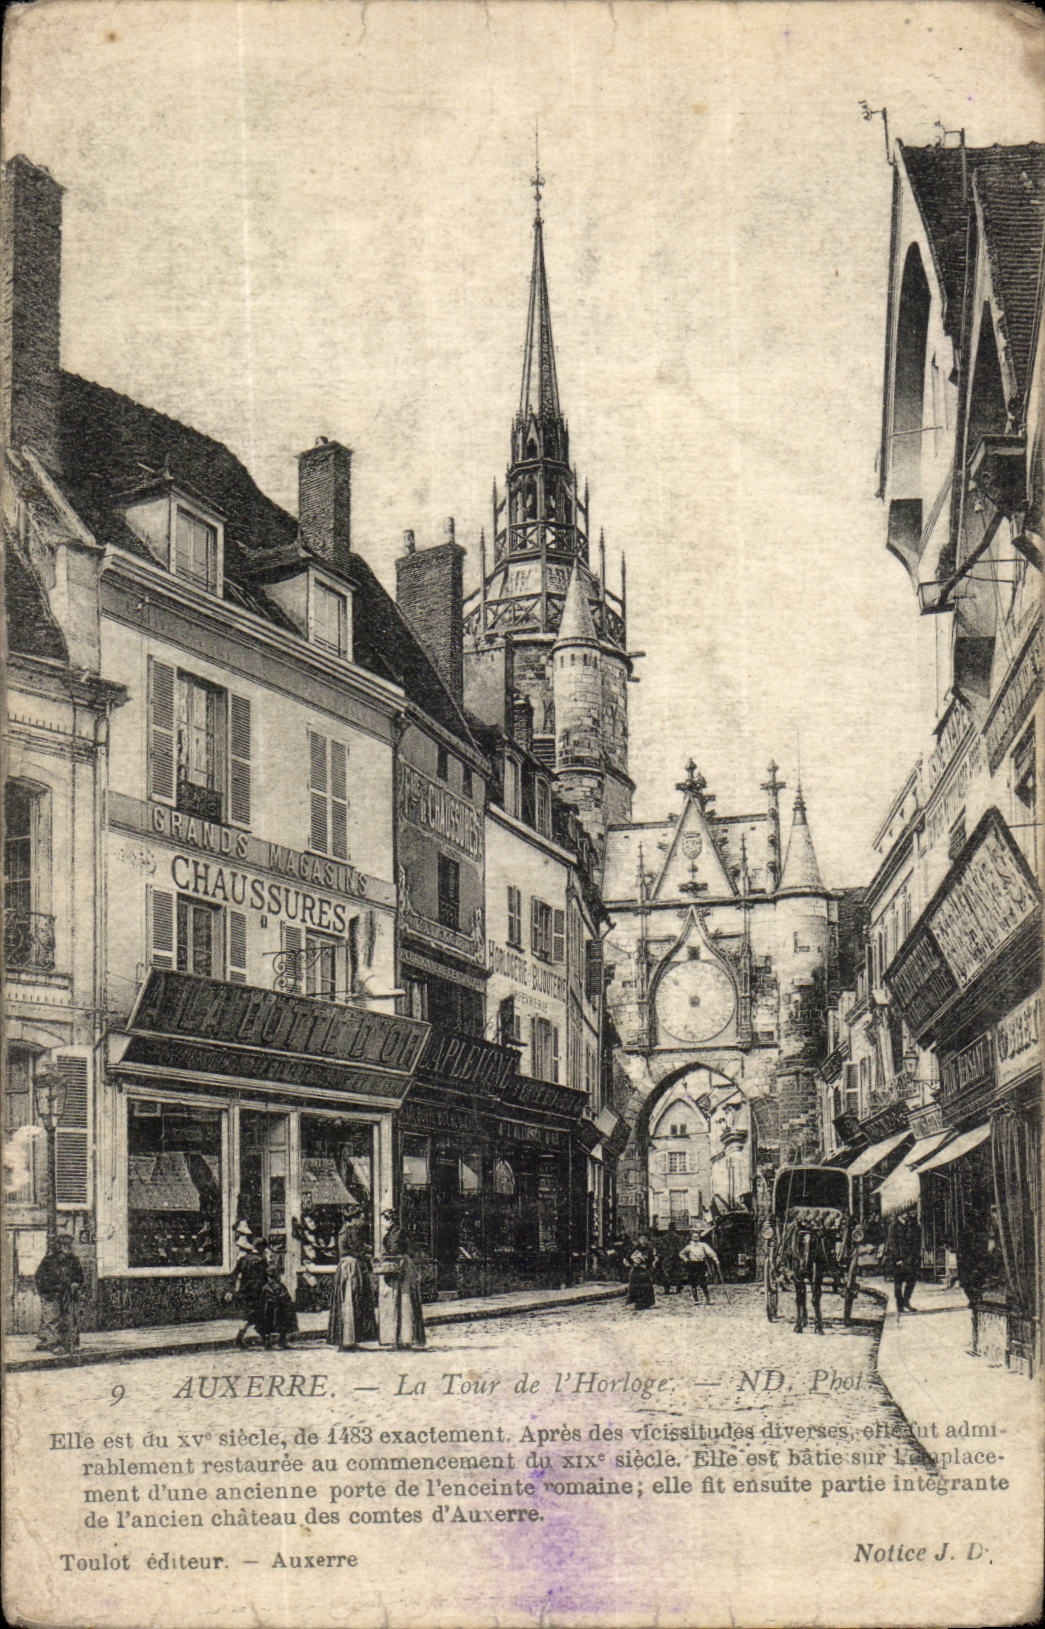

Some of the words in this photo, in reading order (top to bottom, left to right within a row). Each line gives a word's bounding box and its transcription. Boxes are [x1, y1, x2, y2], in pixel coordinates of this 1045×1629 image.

[152, 806, 249, 859] GRANDS
[268, 842, 367, 897] MAGASINS
[171, 855, 346, 933] CHAUSSURES
